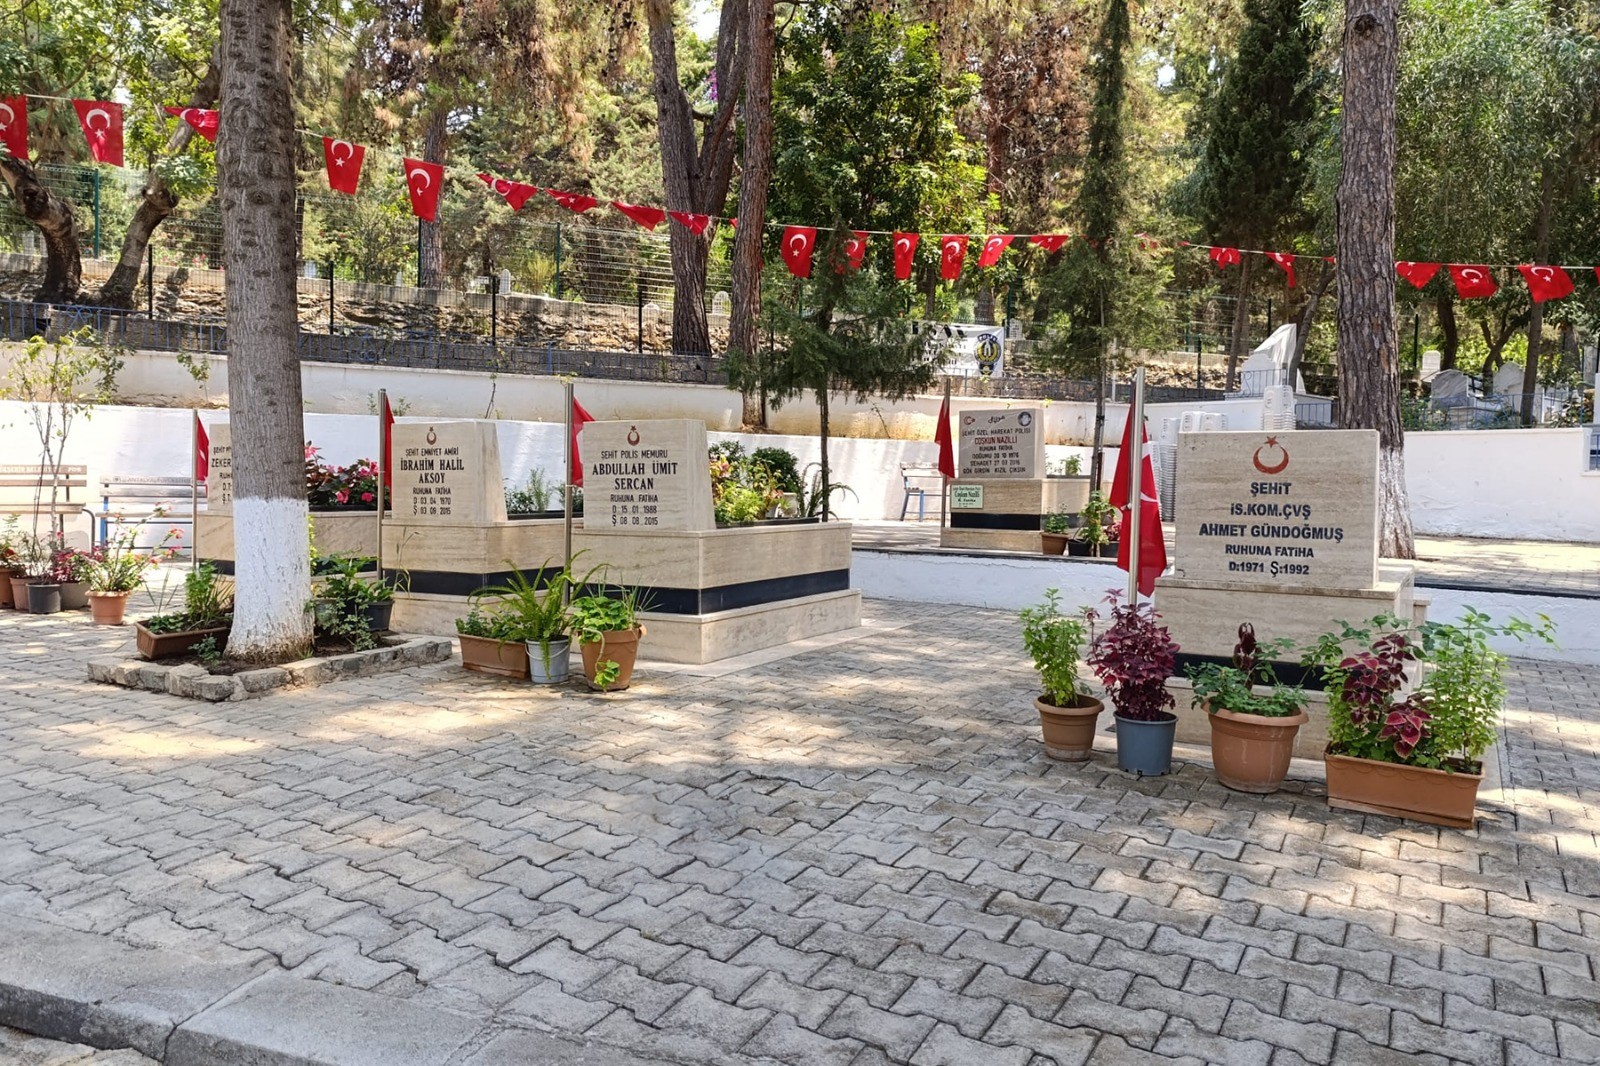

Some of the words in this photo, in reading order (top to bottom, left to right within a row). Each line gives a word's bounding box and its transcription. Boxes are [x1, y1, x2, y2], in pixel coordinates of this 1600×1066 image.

[641, 449, 668, 458] MEMURU
[211, 458, 232, 468] ZEKER
[400, 457, 434, 470] İBRAHİM
[440, 457, 464, 470] HALİL
[592, 463, 645, 475] ABDULLAH
[652, 460, 678, 475] ÜMİT
[419, 472, 445, 484] AKSOY
[615, 478, 654, 490] SERCAN
[610, 494, 634, 502] RUHUNA
[1199, 523, 1247, 537] AHMET
[1251, 523, 1344, 543] GÜNDOĞMUŞ
[1225, 544, 1272, 556] RUHUNA
[1229, 561, 1264, 572] D:1971
